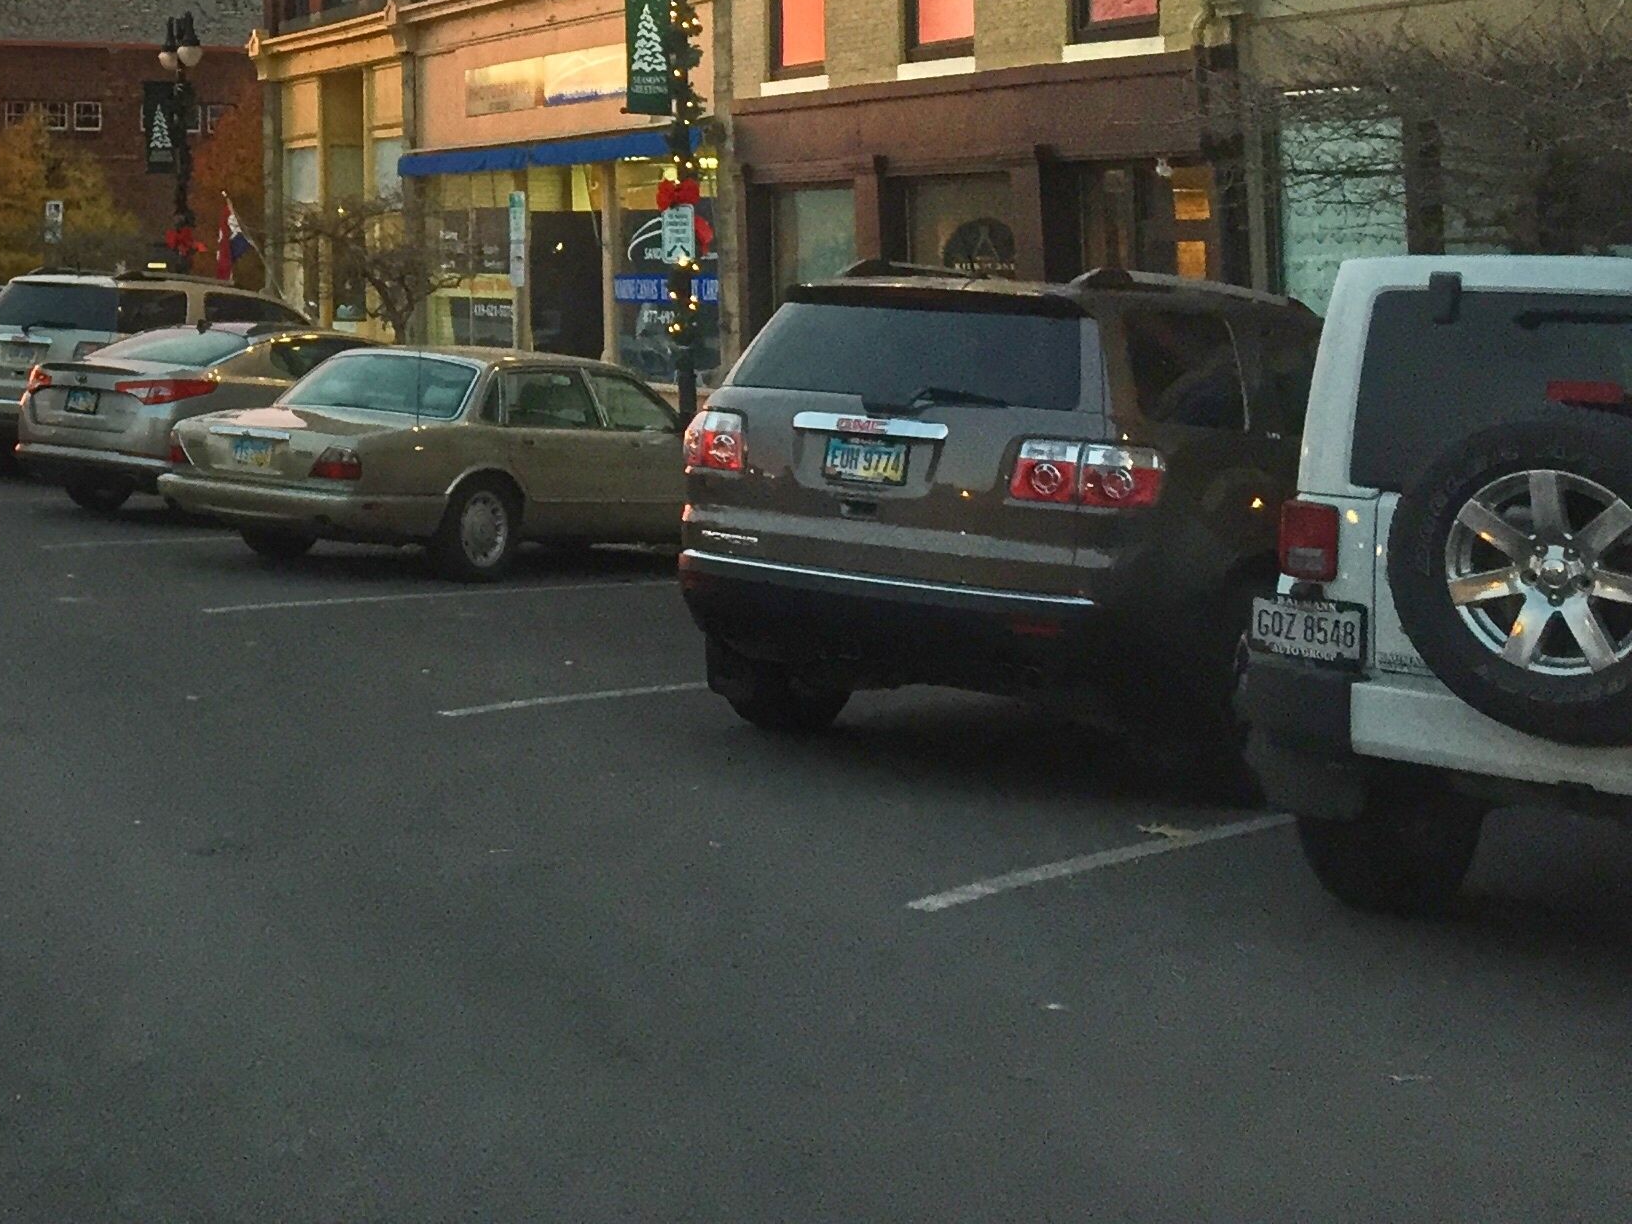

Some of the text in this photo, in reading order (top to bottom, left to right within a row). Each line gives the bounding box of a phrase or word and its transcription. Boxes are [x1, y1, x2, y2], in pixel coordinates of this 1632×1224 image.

[837, 418, 888, 434] GMC
[862, 449, 901, 475] 9774
[1303, 615, 1356, 649] 8548
